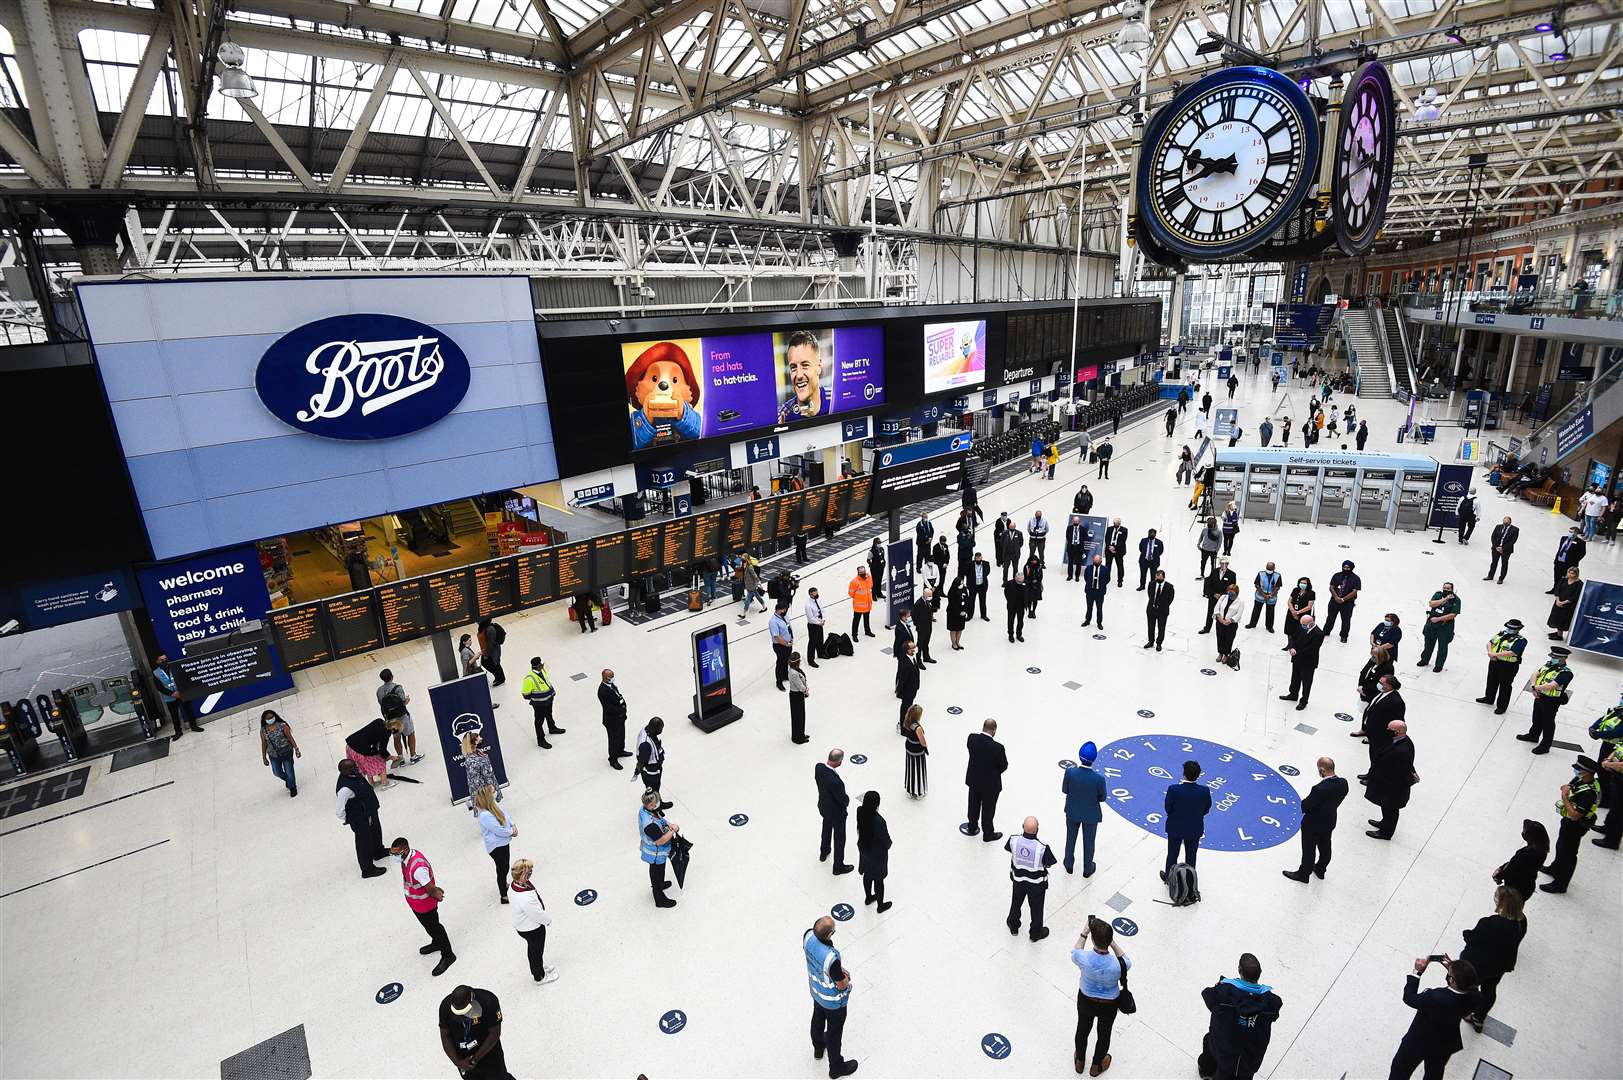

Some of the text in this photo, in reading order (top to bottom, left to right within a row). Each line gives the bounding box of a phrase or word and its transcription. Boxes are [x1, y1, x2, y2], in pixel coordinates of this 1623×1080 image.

[928, 337, 954, 356] SUPER
[710, 352, 730, 360] From
[929, 350, 955, 367] RELIABLE
[712, 362, 742, 372] red hats
[842, 361, 854, 369] New
[296, 336, 445, 423] Boots
[1004, 367, 1034, 382] Departures
[714, 378, 722, 386] to
[882, 422, 900, 431] 13 13
[1559, 416, 1584, 438] Waterloo East
[1289, 456, 1357, 466] Self-service tickets
[652, 472, 674, 484] 12 12
[159, 562, 245, 590] welcome
[895, 582, 909, 590] Please
[903, 588, 912, 596] your
[166, 585, 224, 607] pharmacy
[893, 596, 910, 605] distance
[170, 602, 209, 618] beauty
[174, 606, 244, 630] food & drink
[178, 617, 246, 642] baby & child
[181, 660, 199, 668] Please
[227, 648, 253, 656] observing
[191, 671, 223, 681] Stonehaven
[224, 665, 246, 673] accident
[1144, 742, 1156, 752] 1
[1181, 743, 1193, 752] 2
[1114, 749, 1135, 761] 12
[1218, 753, 1232, 762] 3
[1105, 768, 1122, 778] 11
[1251, 773, 1267, 782] 4
[1206, 776, 1227, 790] the
[1112, 788, 1134, 803] 10
[1267, 795, 1287, 805] 5
[1216, 792, 1240, 812] clock
[1261, 816, 1281, 828] 6
[1237, 827, 1253, 841] 7
